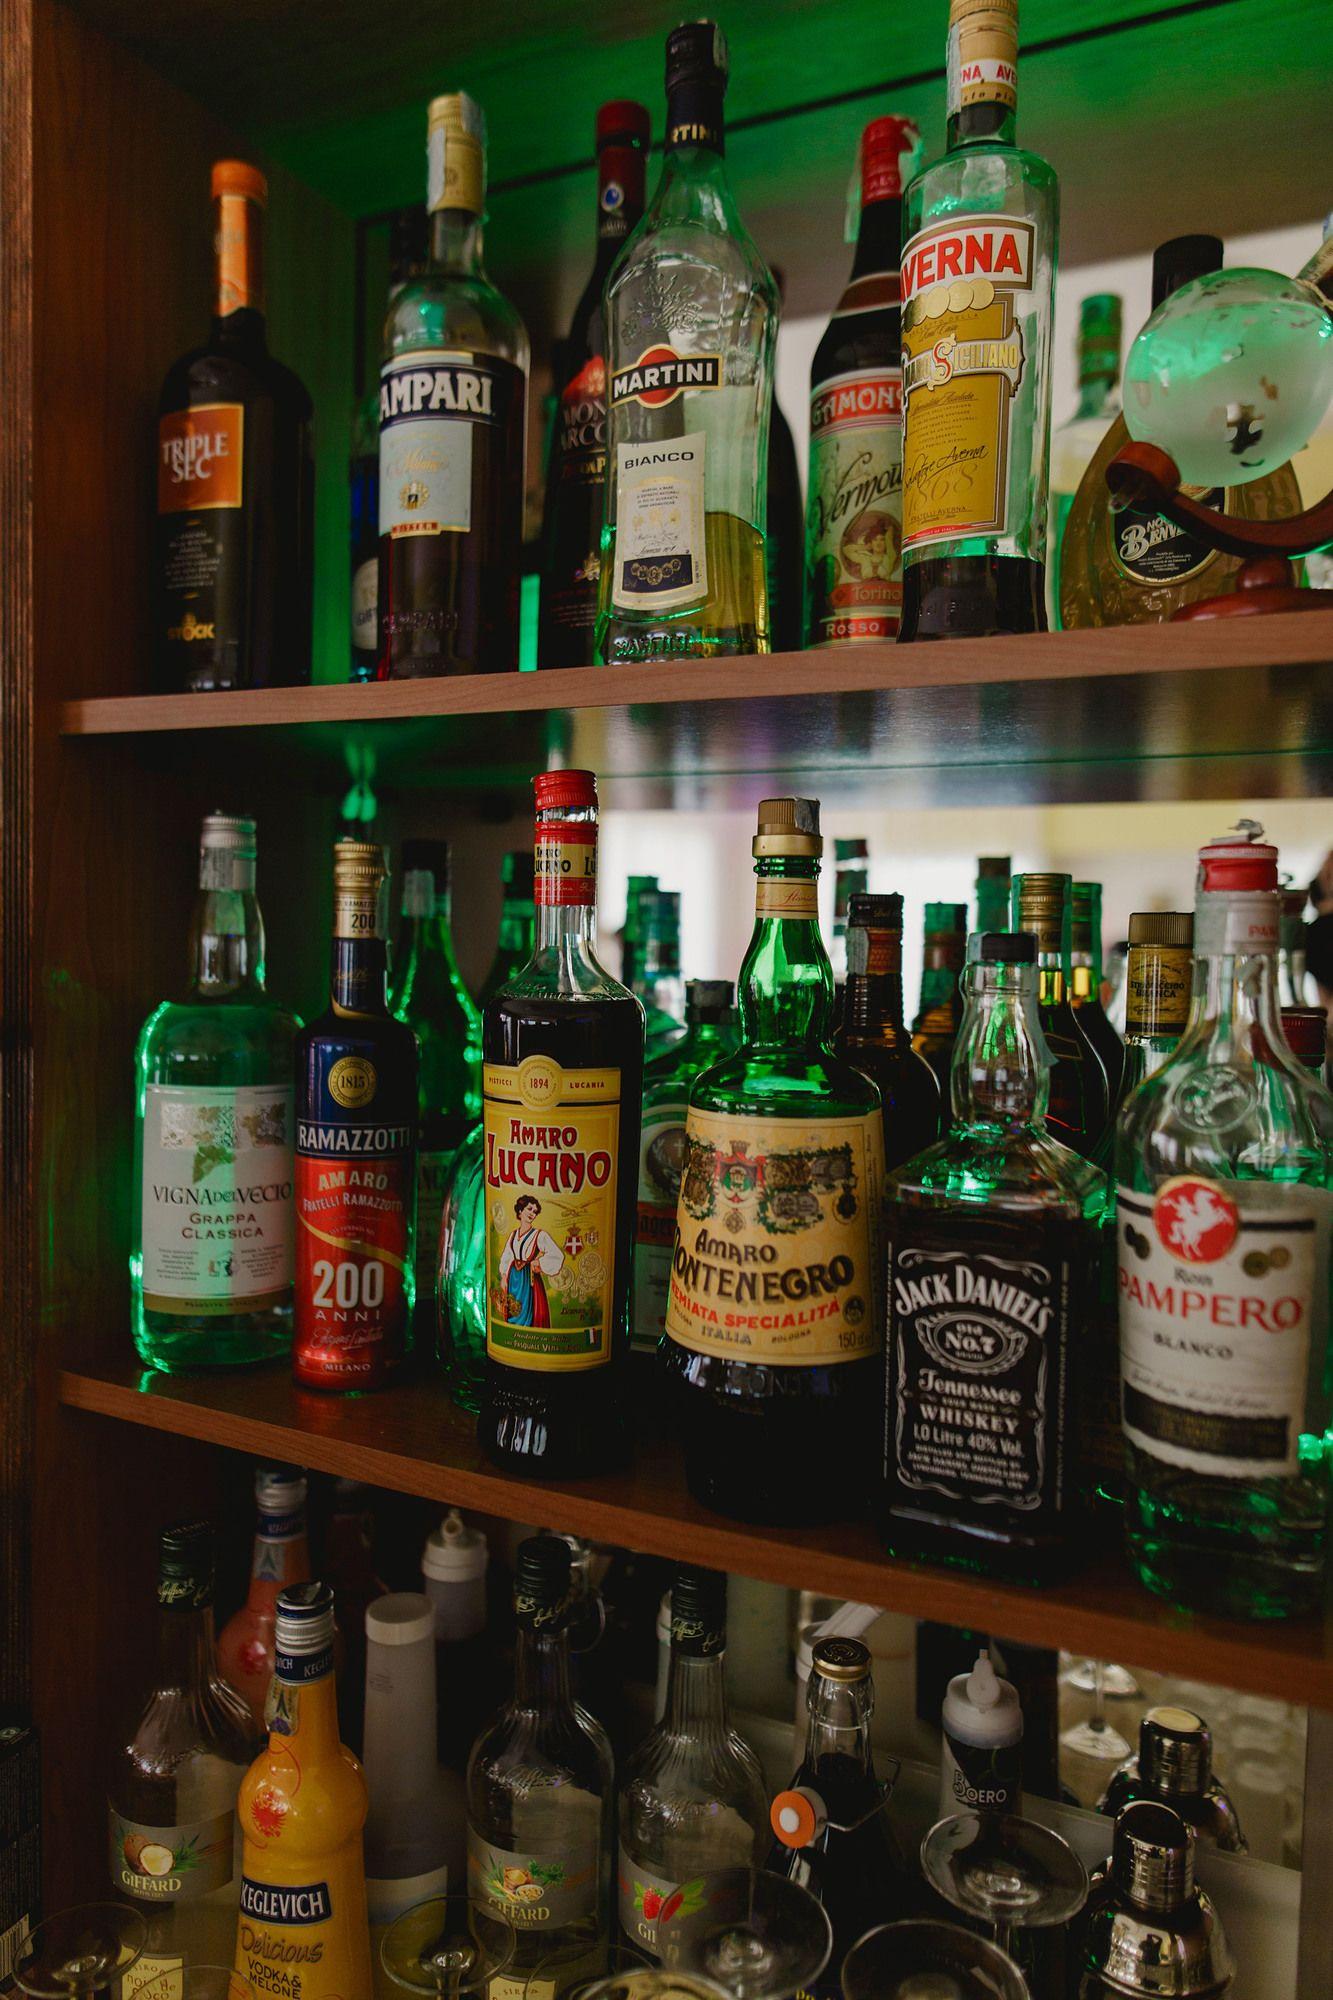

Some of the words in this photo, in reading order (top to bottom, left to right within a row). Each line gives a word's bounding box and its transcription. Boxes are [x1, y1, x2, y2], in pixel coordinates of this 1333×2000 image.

[613, 362, 713, 400] MARTINI
[162, 431, 230, 466] TRIPLE
[624, 451, 695, 470] BIANCO
[170, 453, 212, 484] SEC
[851, 586, 902, 602] Torino
[826, 621, 880, 638] ROSSO
[351, 913, 377, 930] 200
[341, 1074, 366, 1089] 1815
[529, 1077, 550, 1090] 1894
[569, 1081, 606, 1090] LUCANIA
[299, 1124, 411, 1152] RAMAZZOTTI
[510, 1118, 578, 1150] AMARO
[487, 1132, 612, 1194] LUCANO
[317, 1170, 389, 1193] AMARO
[303, 1194, 340, 1212] FRATELLI
[189, 1212, 257, 1225] GRAPPA
[182, 1226, 264, 1241] CLASSICA
[696, 1228, 779, 1266] AMARO
[312, 1259, 385, 1310] 200
[895, 1272, 955, 1317] JACK
[1118, 1265, 1303, 1335] PAMPERO
[314, 1310, 382, 1323] ANNI
[701, 1325, 752, 1346] ITALIA
[839, 1332, 858, 1350] 150
[1152, 1332, 1234, 1360] BLANCO
[324, 1362, 372, 1373] MILANO
[918, 1367, 1022, 1407] Tennessee
[919, 1402, 1020, 1435] WHISKEY
[968, 1432, 998, 1455] 40%
[952, 1768, 1008, 1805] BOERO
[121, 1869, 183, 1893] GIFFARD
[240, 1882, 325, 1918] KEGLEVICH
[241, 1926, 324, 1963] Delicious
[249, 1971, 301, 2000] MELONE
